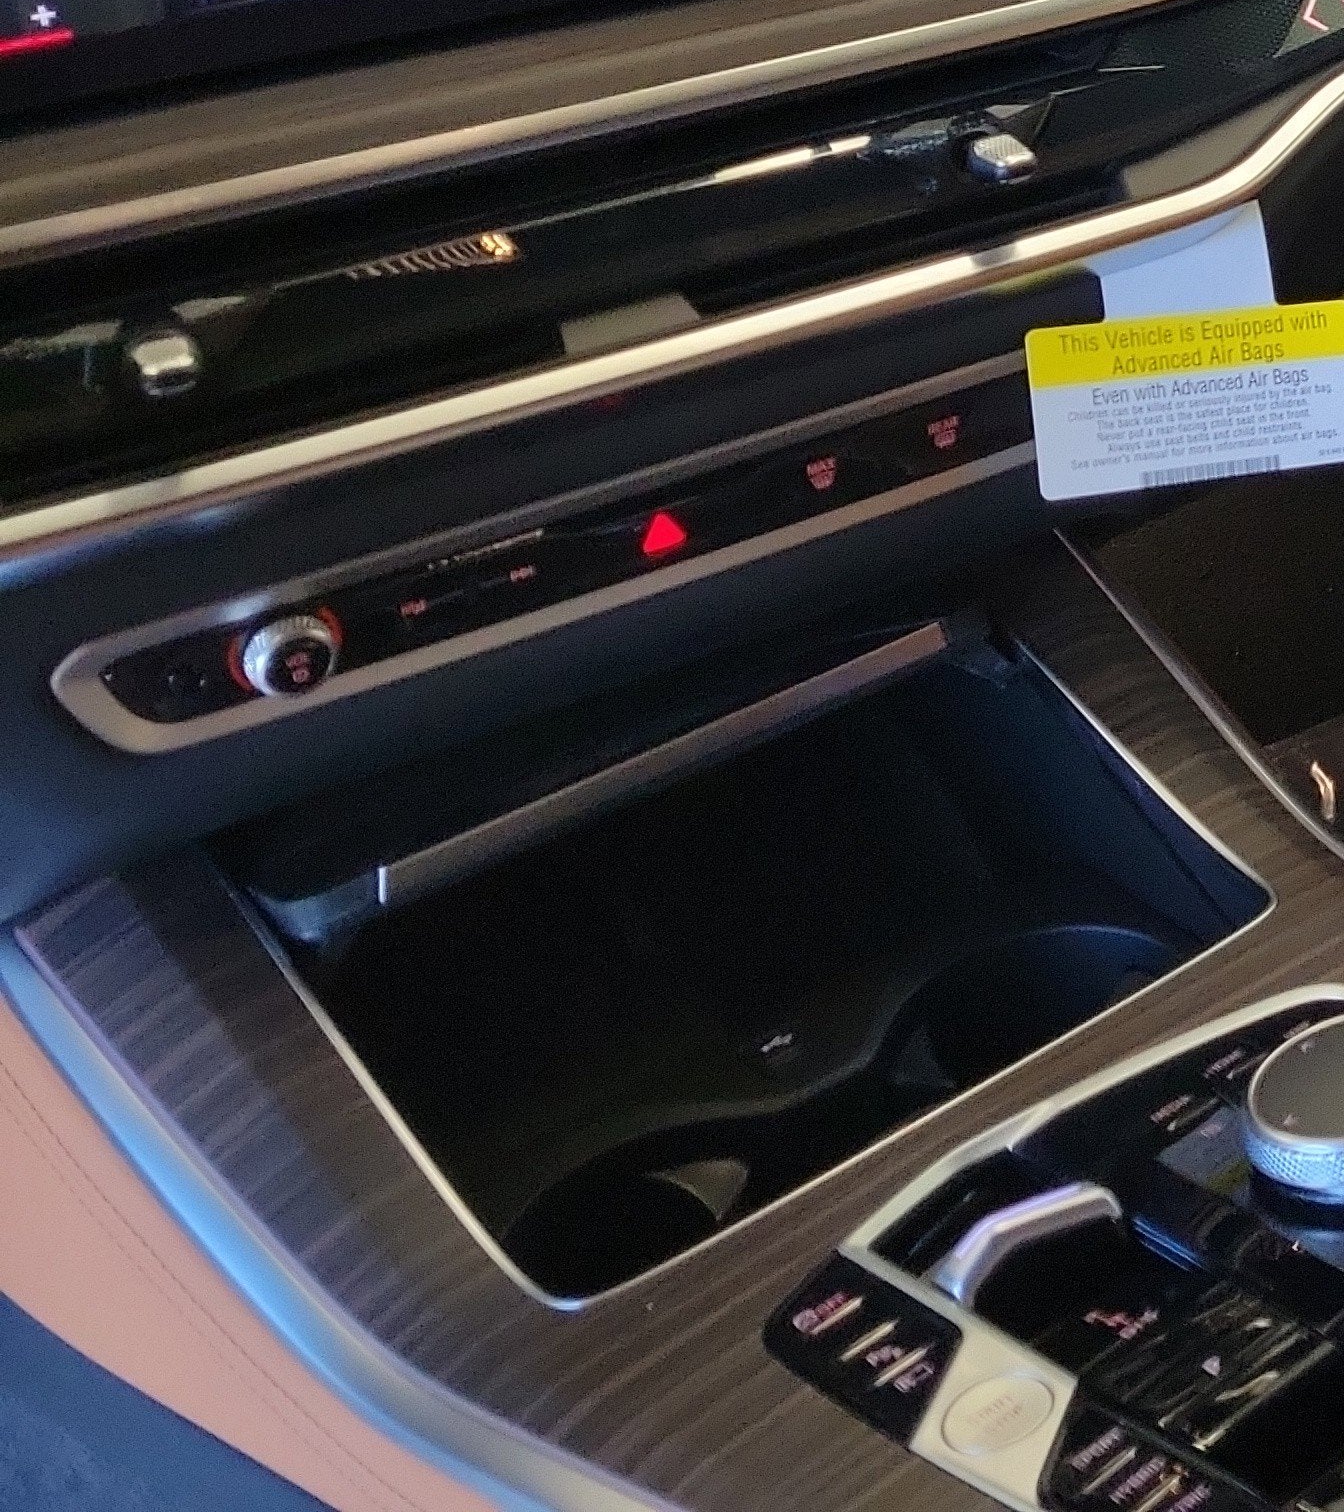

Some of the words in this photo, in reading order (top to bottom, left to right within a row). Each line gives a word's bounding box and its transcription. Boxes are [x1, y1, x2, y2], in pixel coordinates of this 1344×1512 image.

[1058, 332, 1100, 354] This
[1104, 324, 1173, 349] Vehicle
[1179, 325, 1196, 342] is
[1202, 316, 1284, 342] Equipped
[1289, 310, 1328, 331] with
[1111, 349, 1201, 375] Advanced
[1208, 344, 1234, 365] Air
[1241, 341, 1285, 363] Bags
[1092, 386, 1130, 406] Even
[1133, 383, 1168, 401] with
[1171, 376, 1243, 396] Advanced
[1248, 370, 1270, 388] Air
[1272, 366, 1310, 386] Bags
